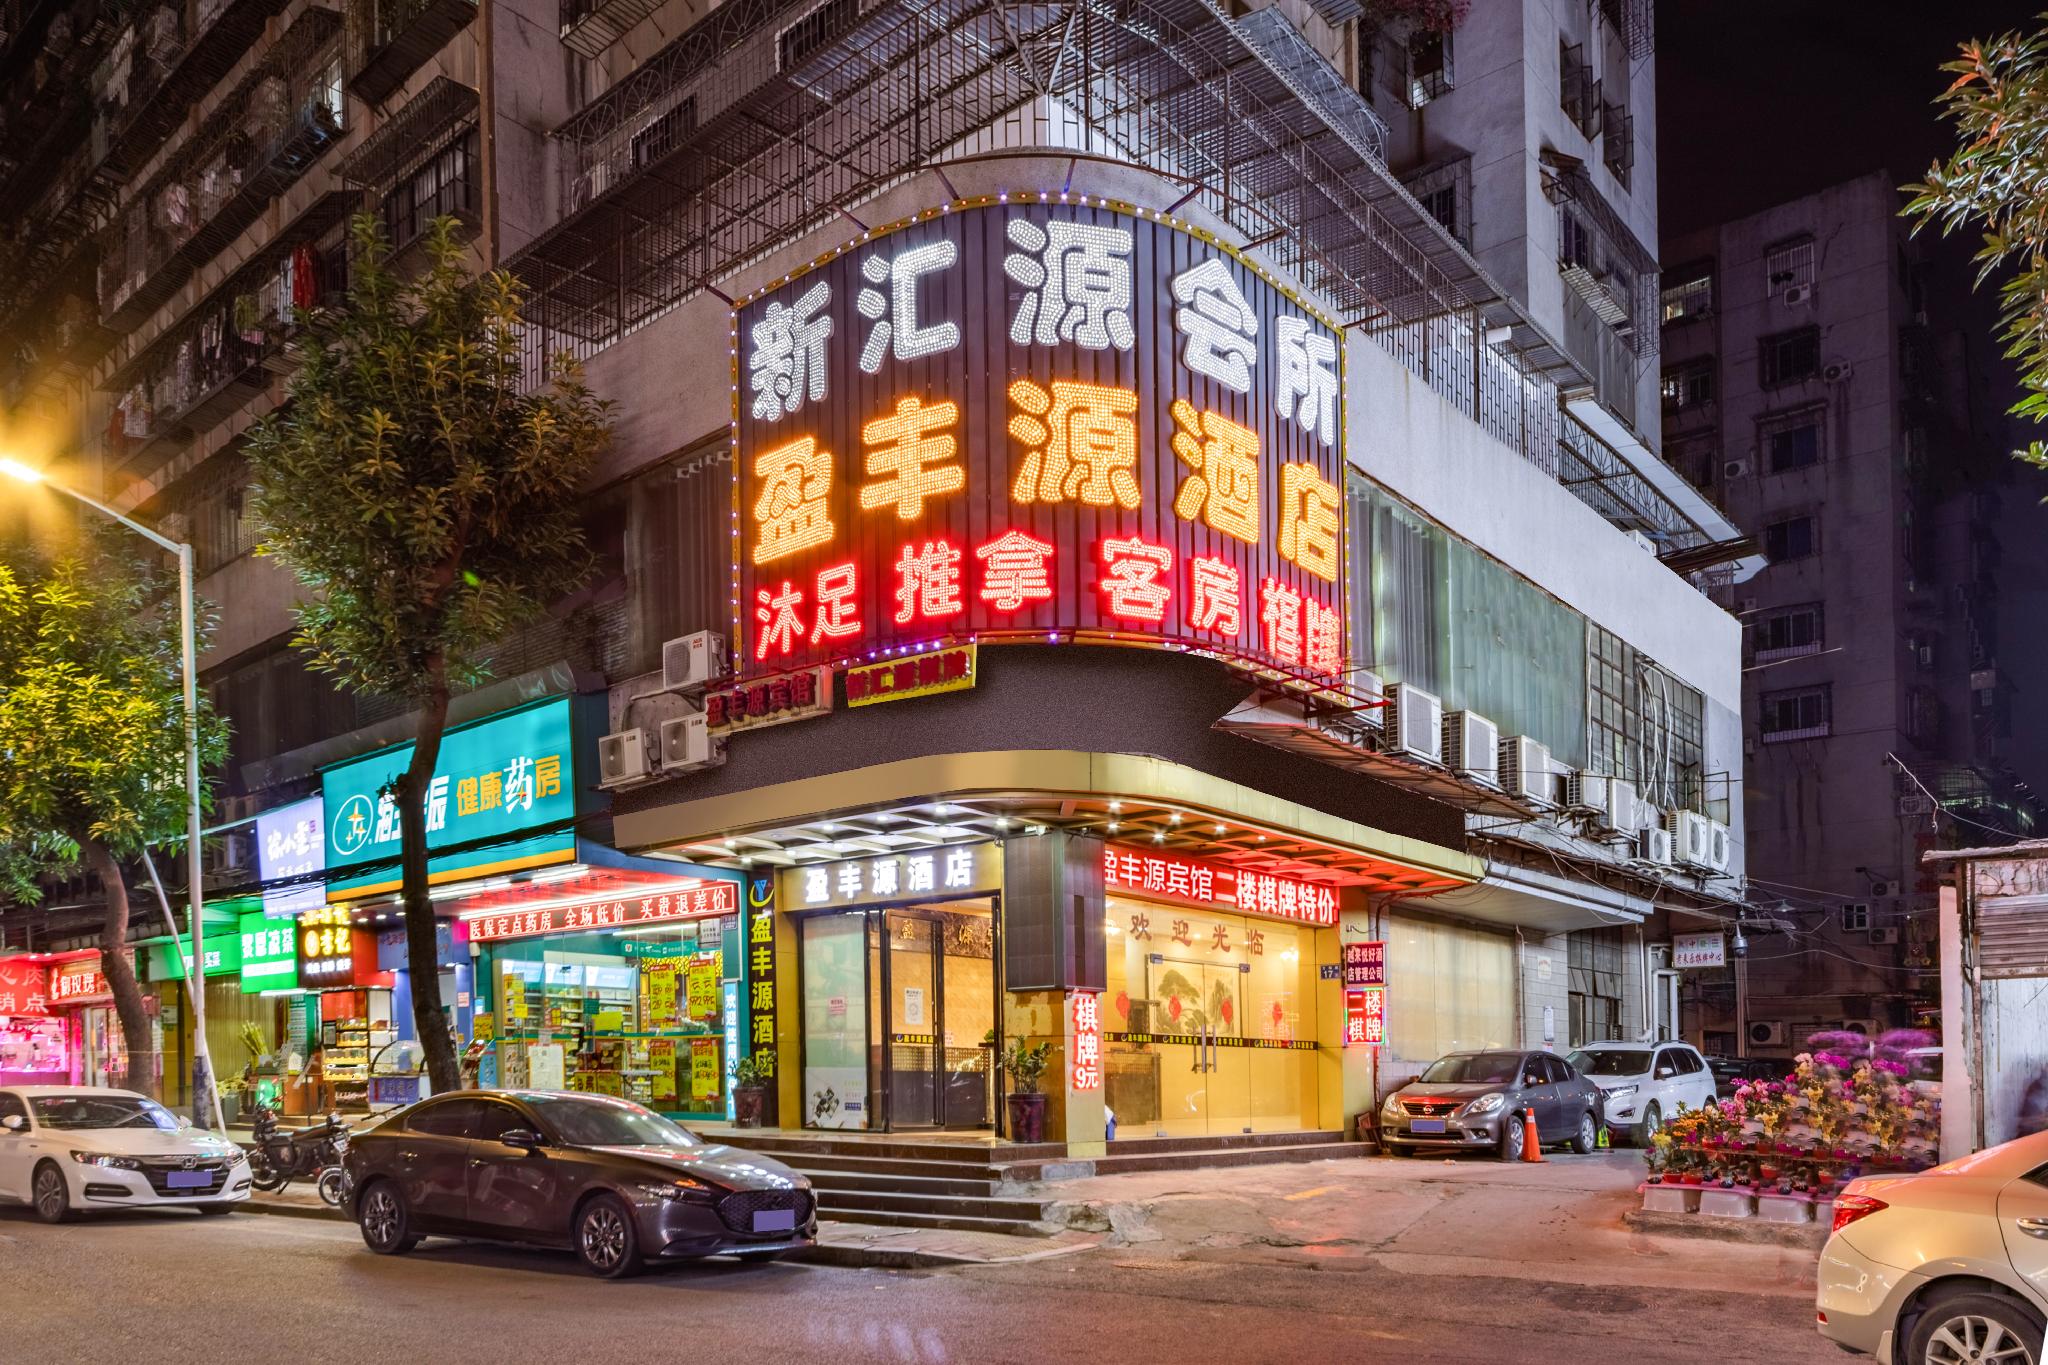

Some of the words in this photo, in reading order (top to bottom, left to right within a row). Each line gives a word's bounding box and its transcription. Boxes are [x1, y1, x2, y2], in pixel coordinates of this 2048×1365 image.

[749, 216, 1337, 446] 新汇源会所
[753, 379, 1339, 582] 盈丰源酒店
[805, 849, 973, 903] 盈丰源酒店
[1105, 851, 1335, 924] 盈丰源宾馆二楼棋牌特价
[470, 910, 553, 938] 医保定点药房
[565, 902, 626, 928] 全场低价
[640, 888, 728, 920] 买贵退差价
[1130, 912, 1265, 957] 欢迎光临
[750, 913, 775, 1078] 盈丰源酒店
[1347, 966, 1383, 982] 店管理公司
[1348, 991, 1382, 1015] 二楼
[1348, 1016, 1382, 1041] 棋牌
